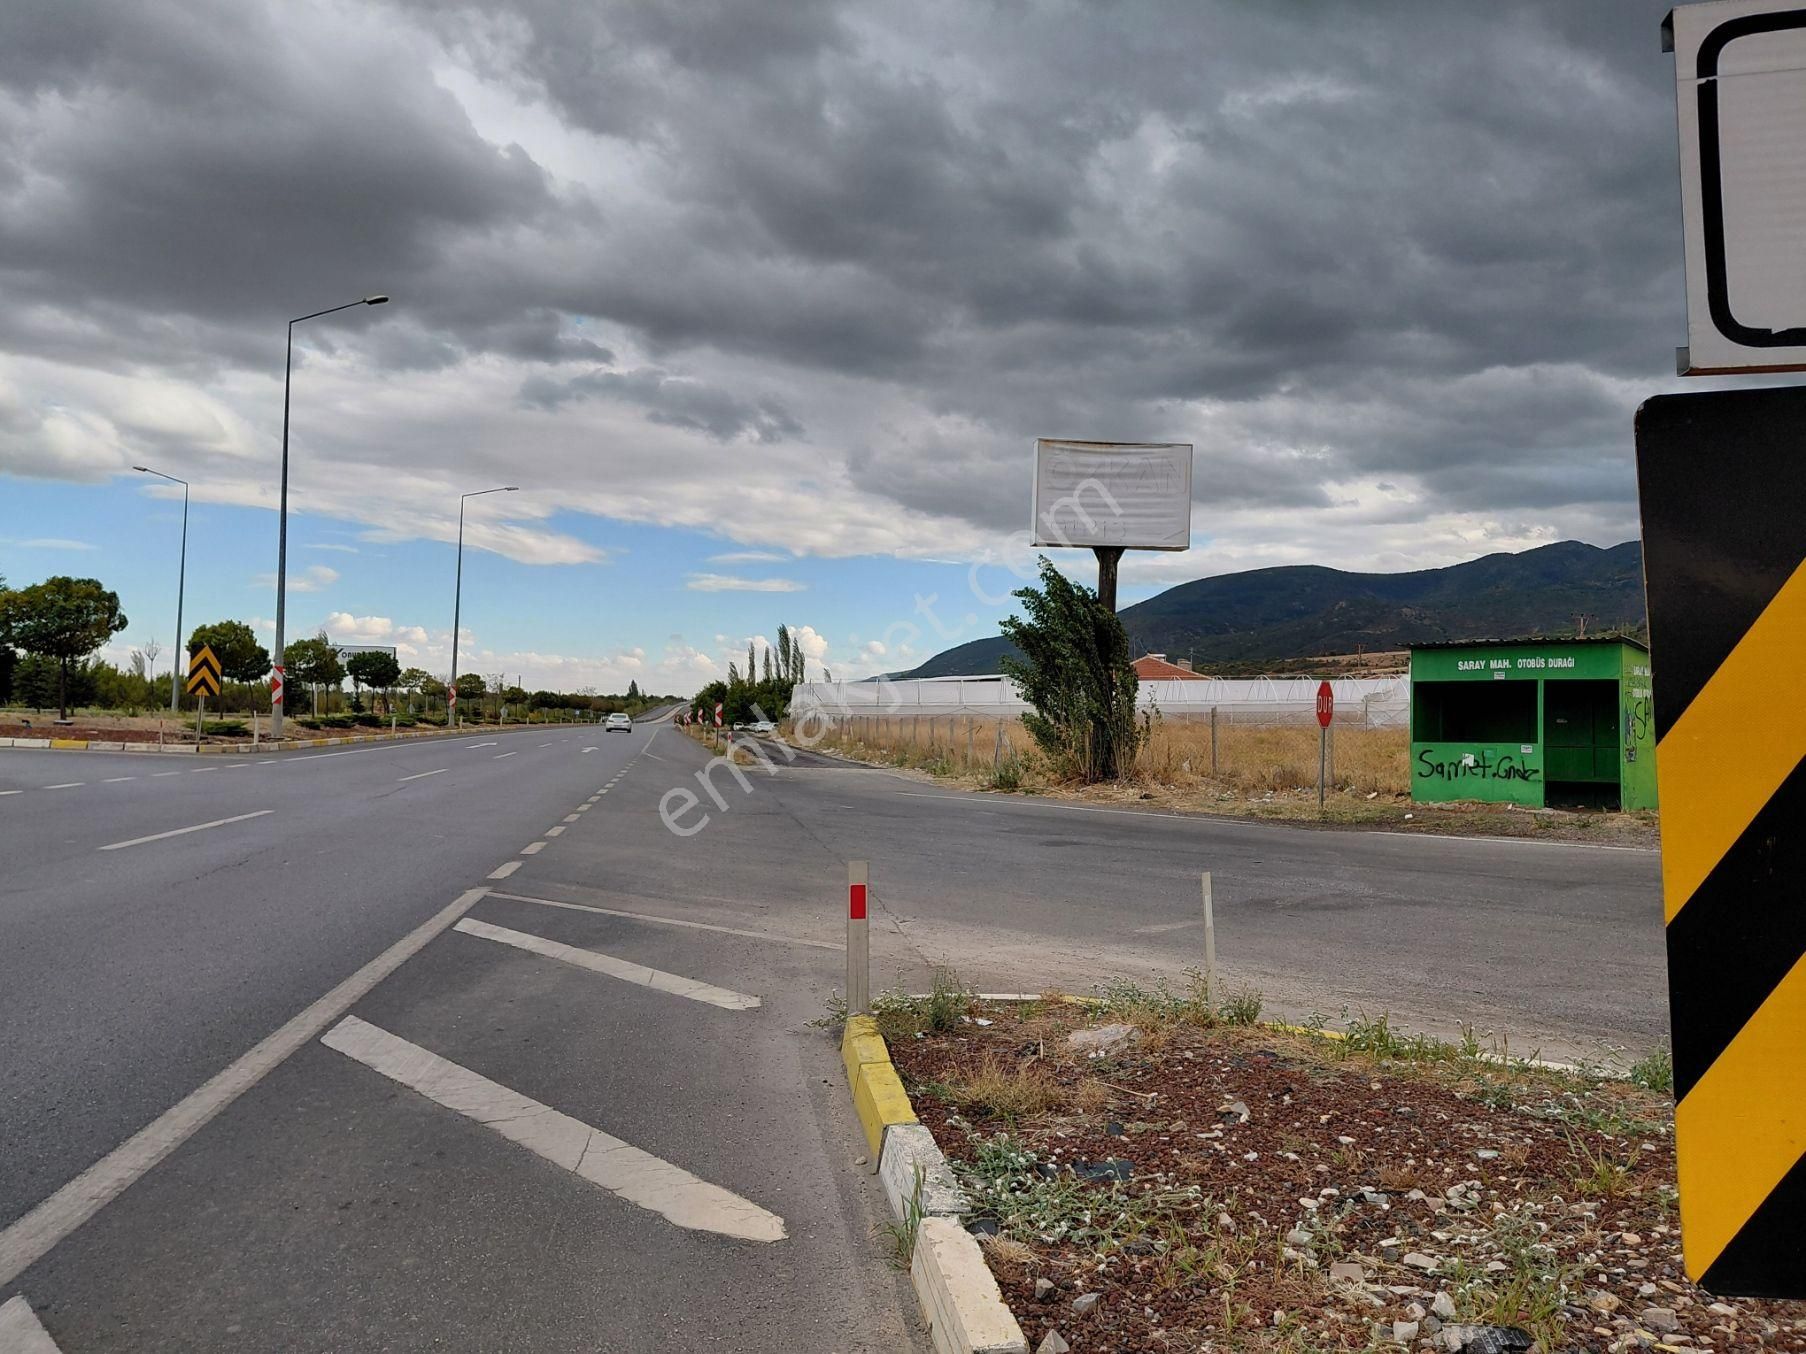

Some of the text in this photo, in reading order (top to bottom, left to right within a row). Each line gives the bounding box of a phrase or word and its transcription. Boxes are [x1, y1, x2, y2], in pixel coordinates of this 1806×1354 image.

[1457, 656, 1575, 671] SARAY MAH. OTOBÜS DURAĞI
[1317, 695, 1333, 714] DUR
